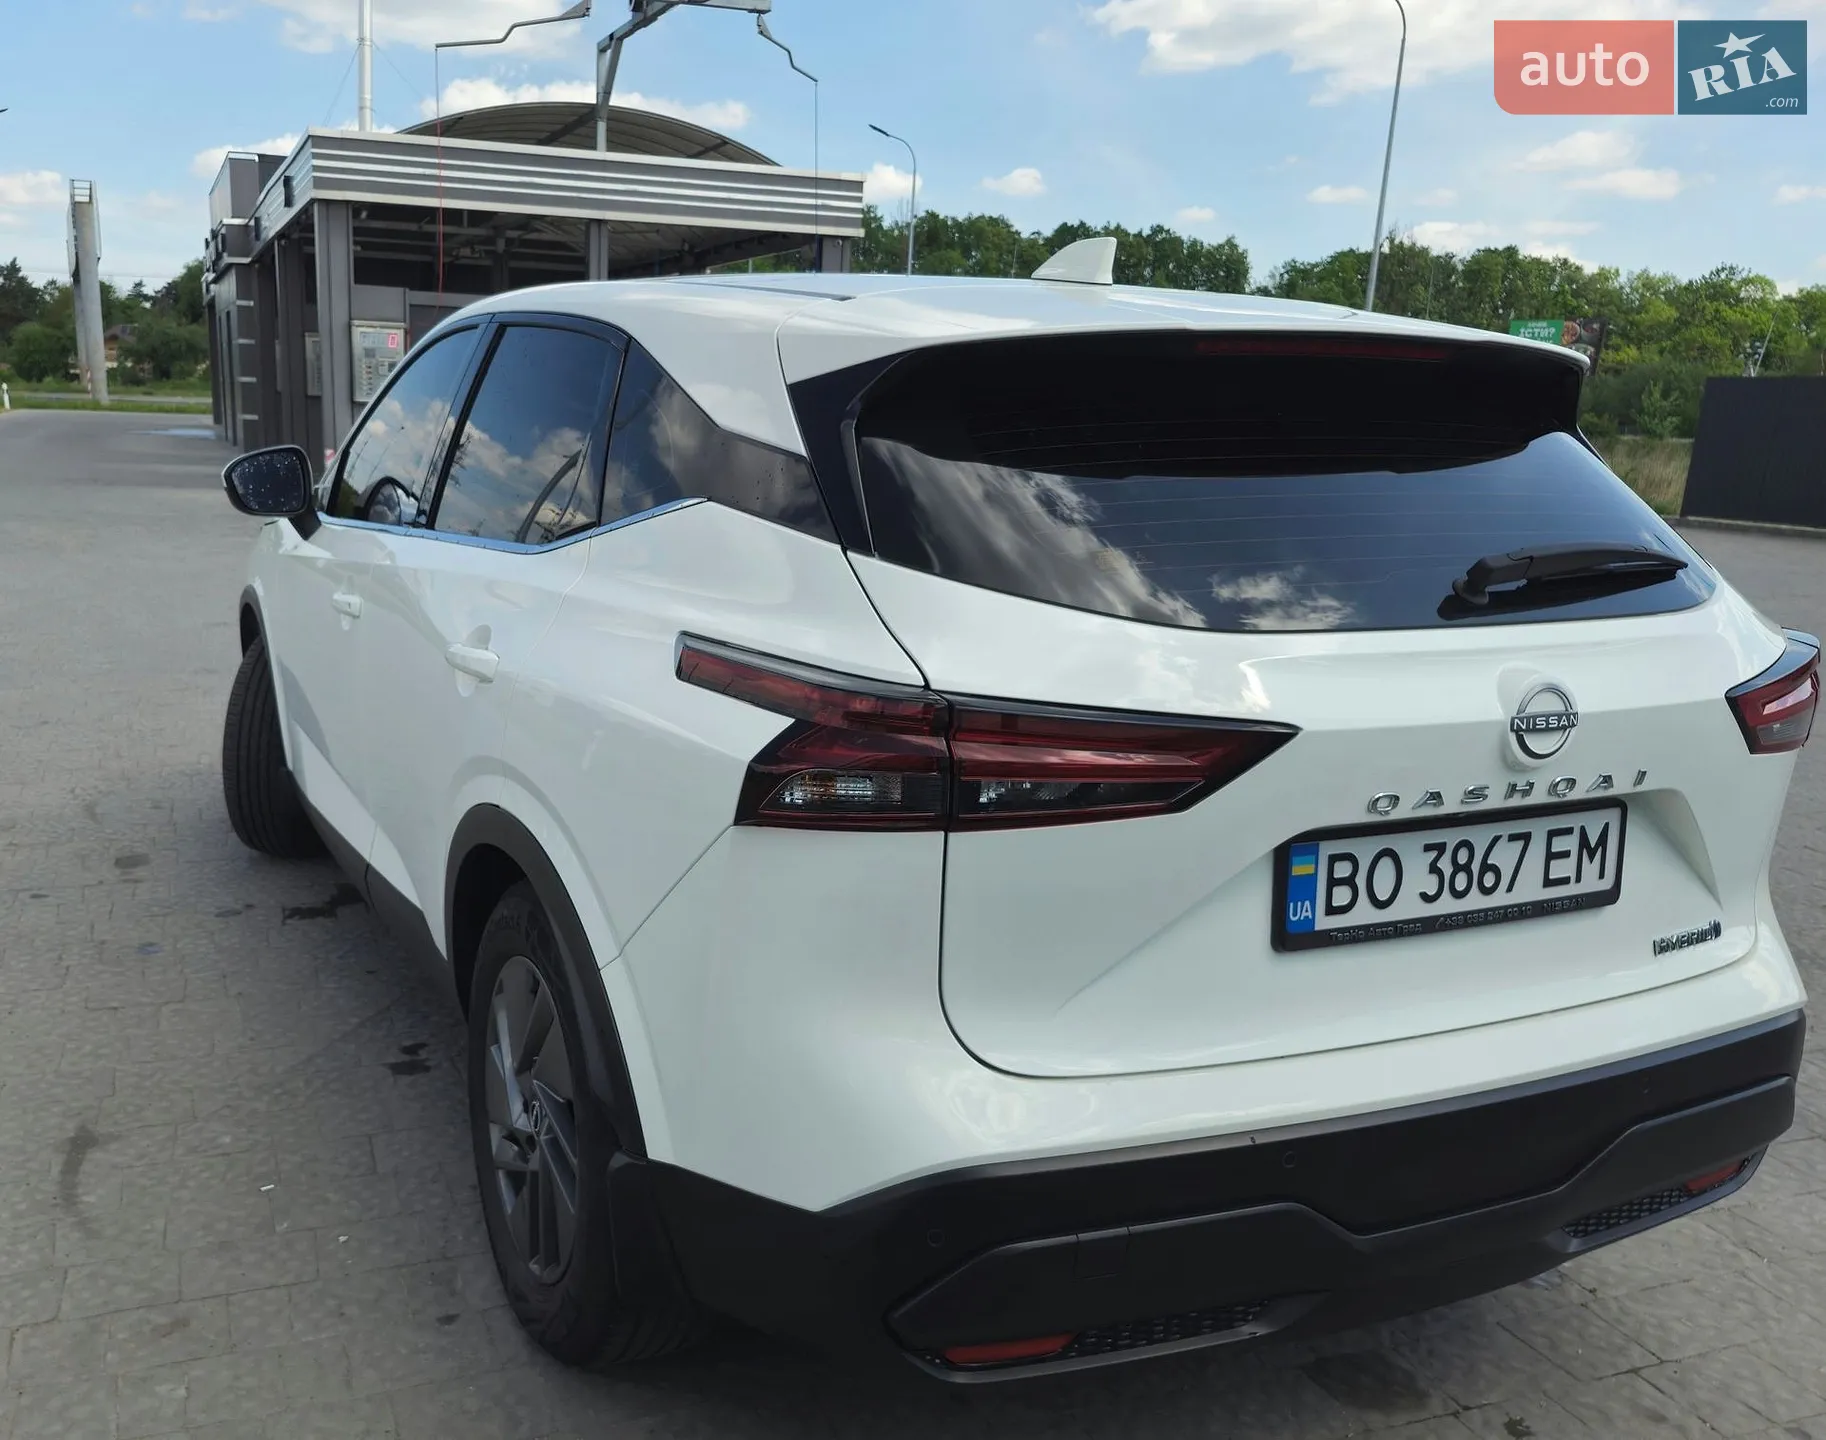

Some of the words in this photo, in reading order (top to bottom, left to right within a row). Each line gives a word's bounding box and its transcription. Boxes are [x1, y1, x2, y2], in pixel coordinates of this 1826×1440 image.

[1513, 713, 1579, 730] NISSAN
[1367, 769, 1648, 816] QASHQAI
[1325, 847, 1403, 916] BO
[1419, 831, 1532, 903] 3867
[1543, 821, 1609, 888] EM
[1289, 900, 1313, 921] UA
